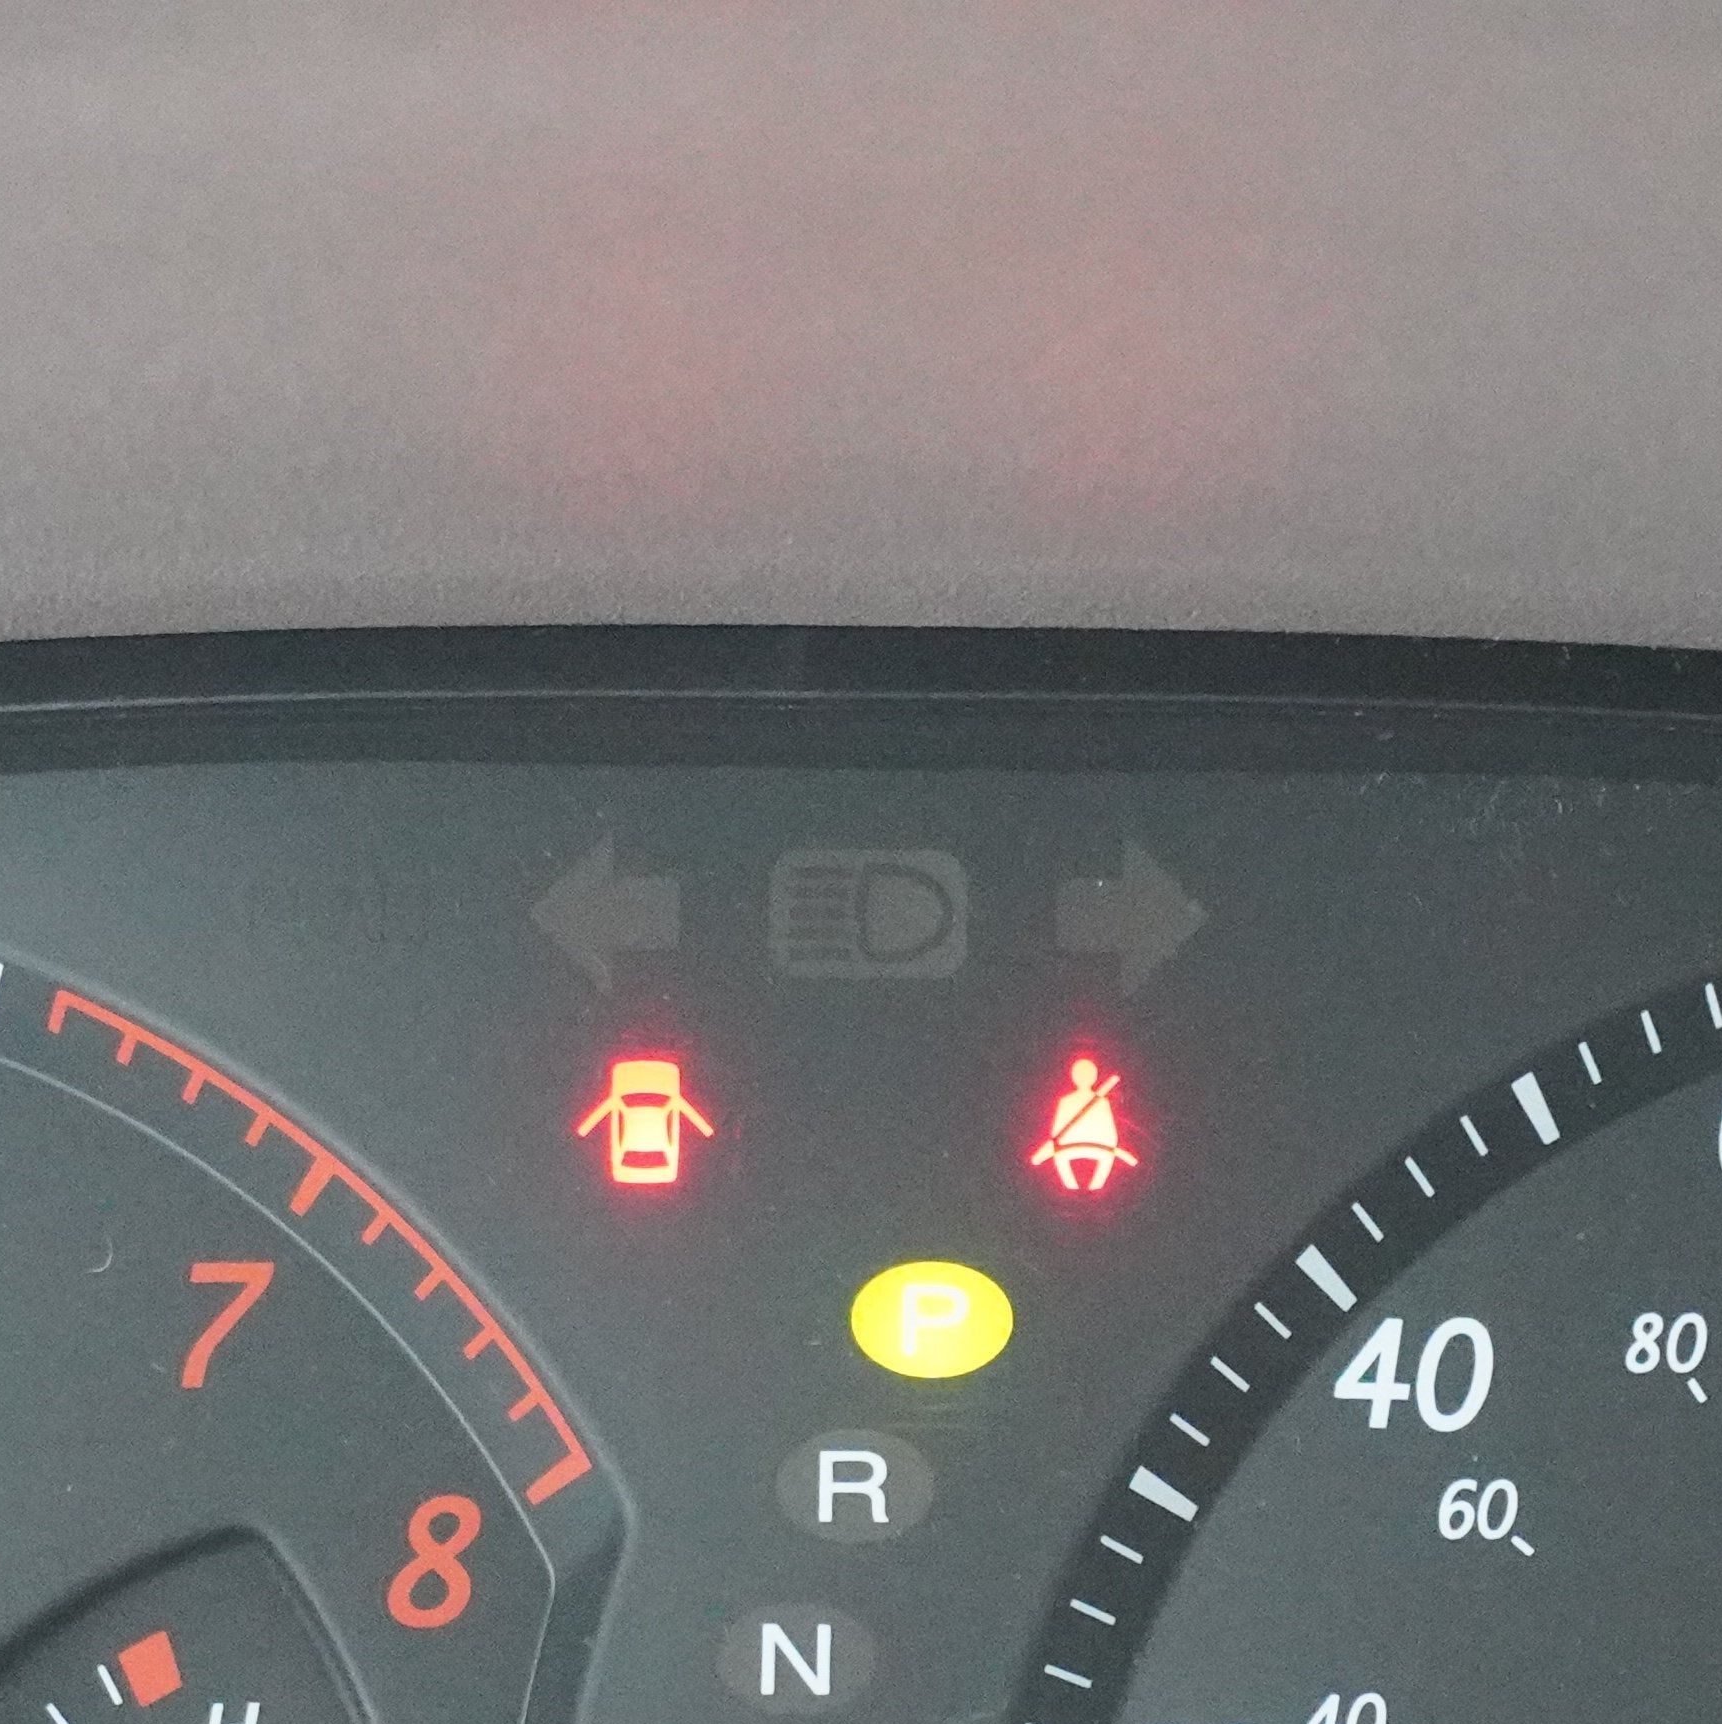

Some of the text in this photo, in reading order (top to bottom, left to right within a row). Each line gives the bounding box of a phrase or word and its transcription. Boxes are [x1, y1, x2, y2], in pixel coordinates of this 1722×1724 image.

[185, 1263, 272, 1387] 7
[899, 1283, 970, 1357] P
[1626, 1313, 1707, 1373] 80
[1334, 1317, 1493, 1432] 40
[819, 1451, 888, 1522] R
[1437, 1478, 1519, 1541] 60
[389, 1496, 479, 1626] 8
[761, 1623, 831, 1695] N
